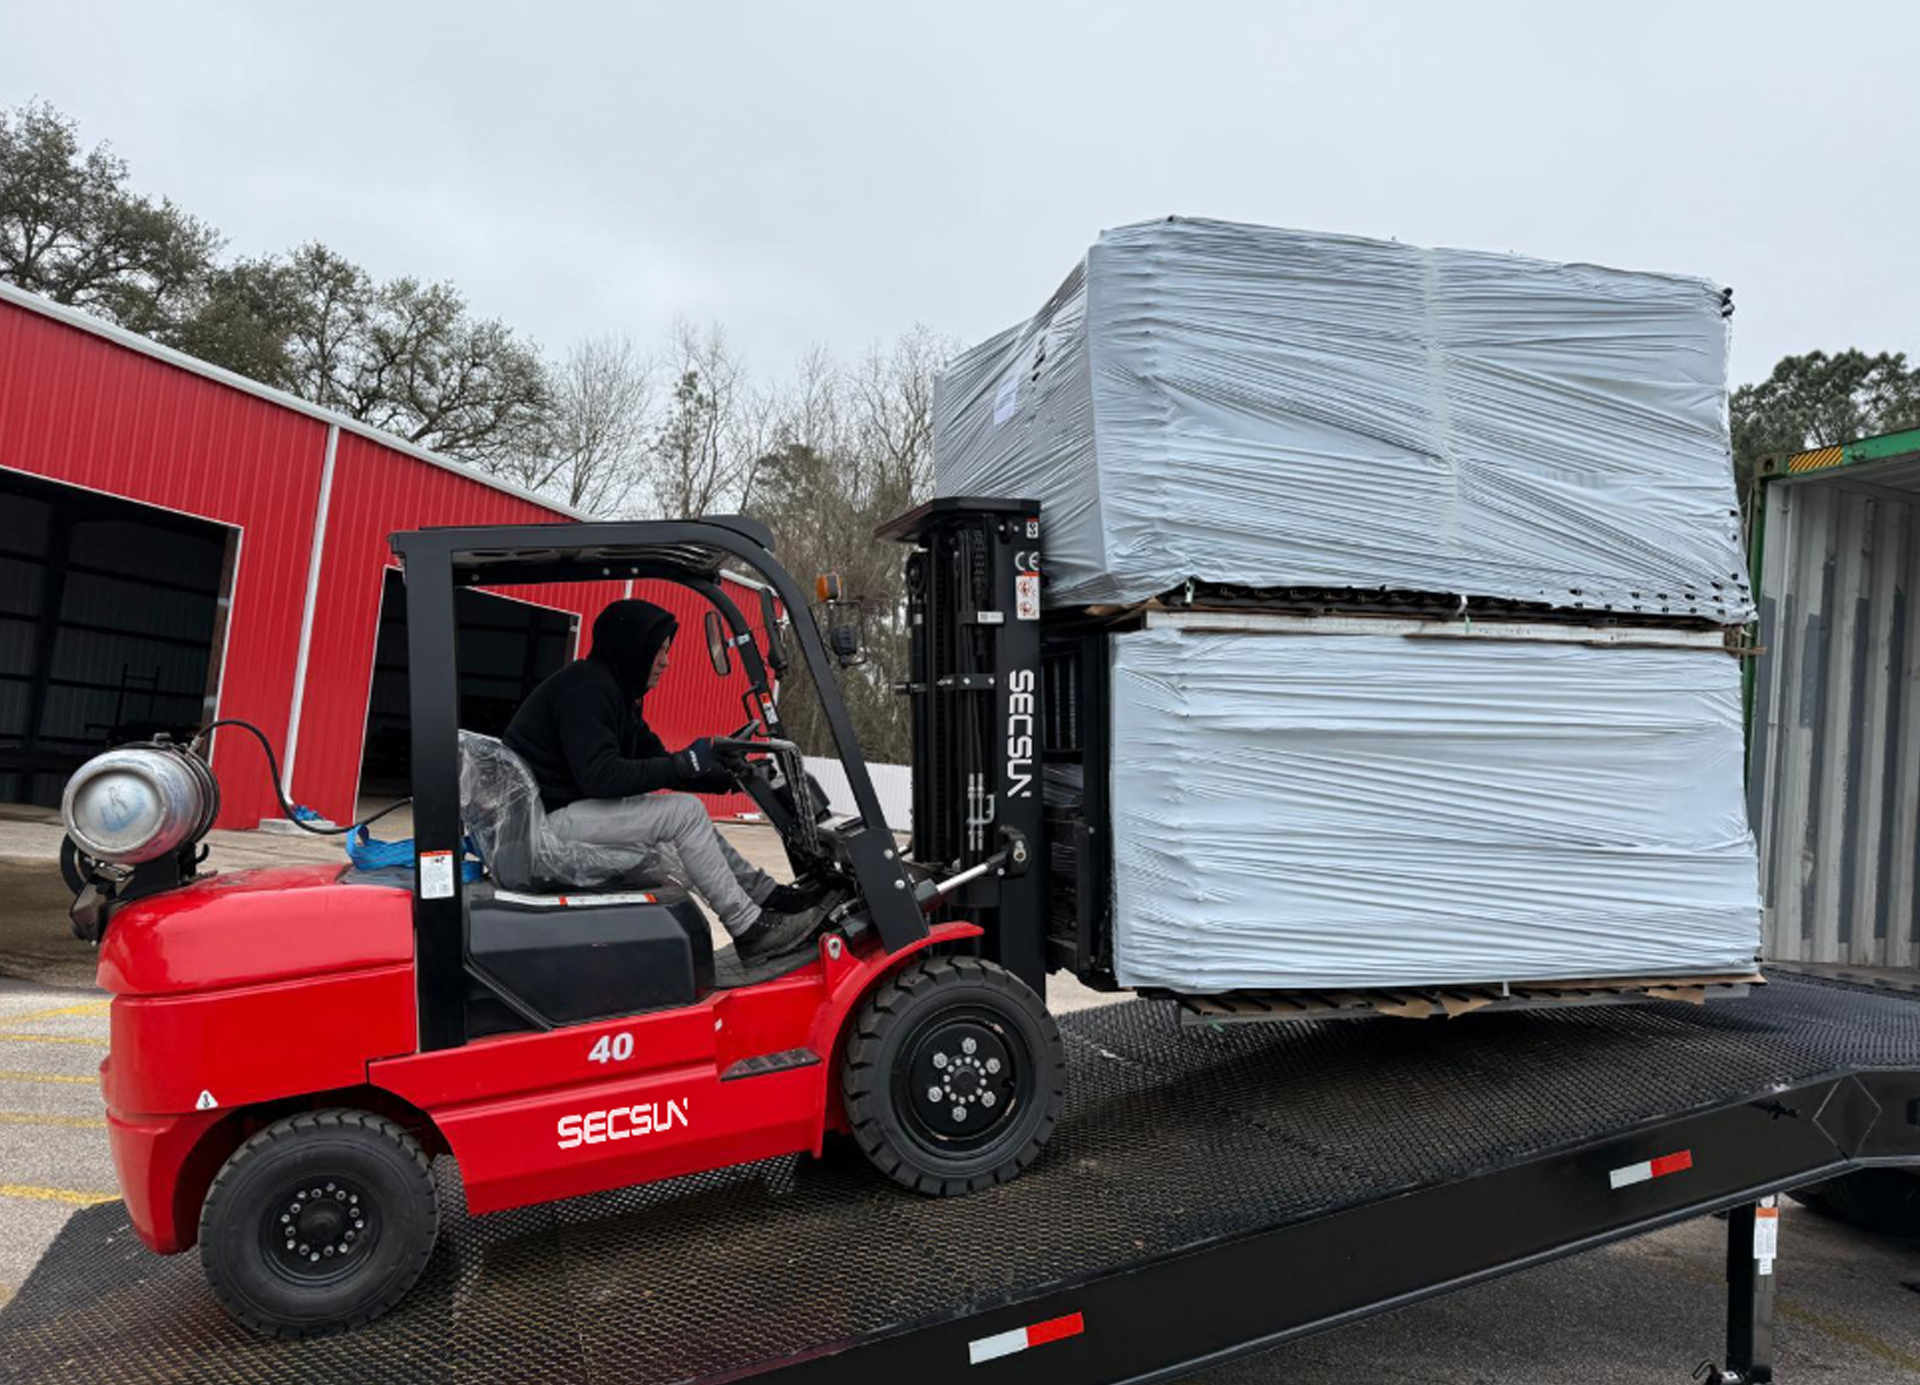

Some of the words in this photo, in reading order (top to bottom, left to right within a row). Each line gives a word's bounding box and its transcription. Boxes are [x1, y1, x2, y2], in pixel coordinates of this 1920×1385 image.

[1014, 551, 1040, 572] CE
[1006, 669, 1035, 798] SECSUN
[587, 1032, 635, 1064] 40
[558, 1097, 688, 1149] SECSUN
